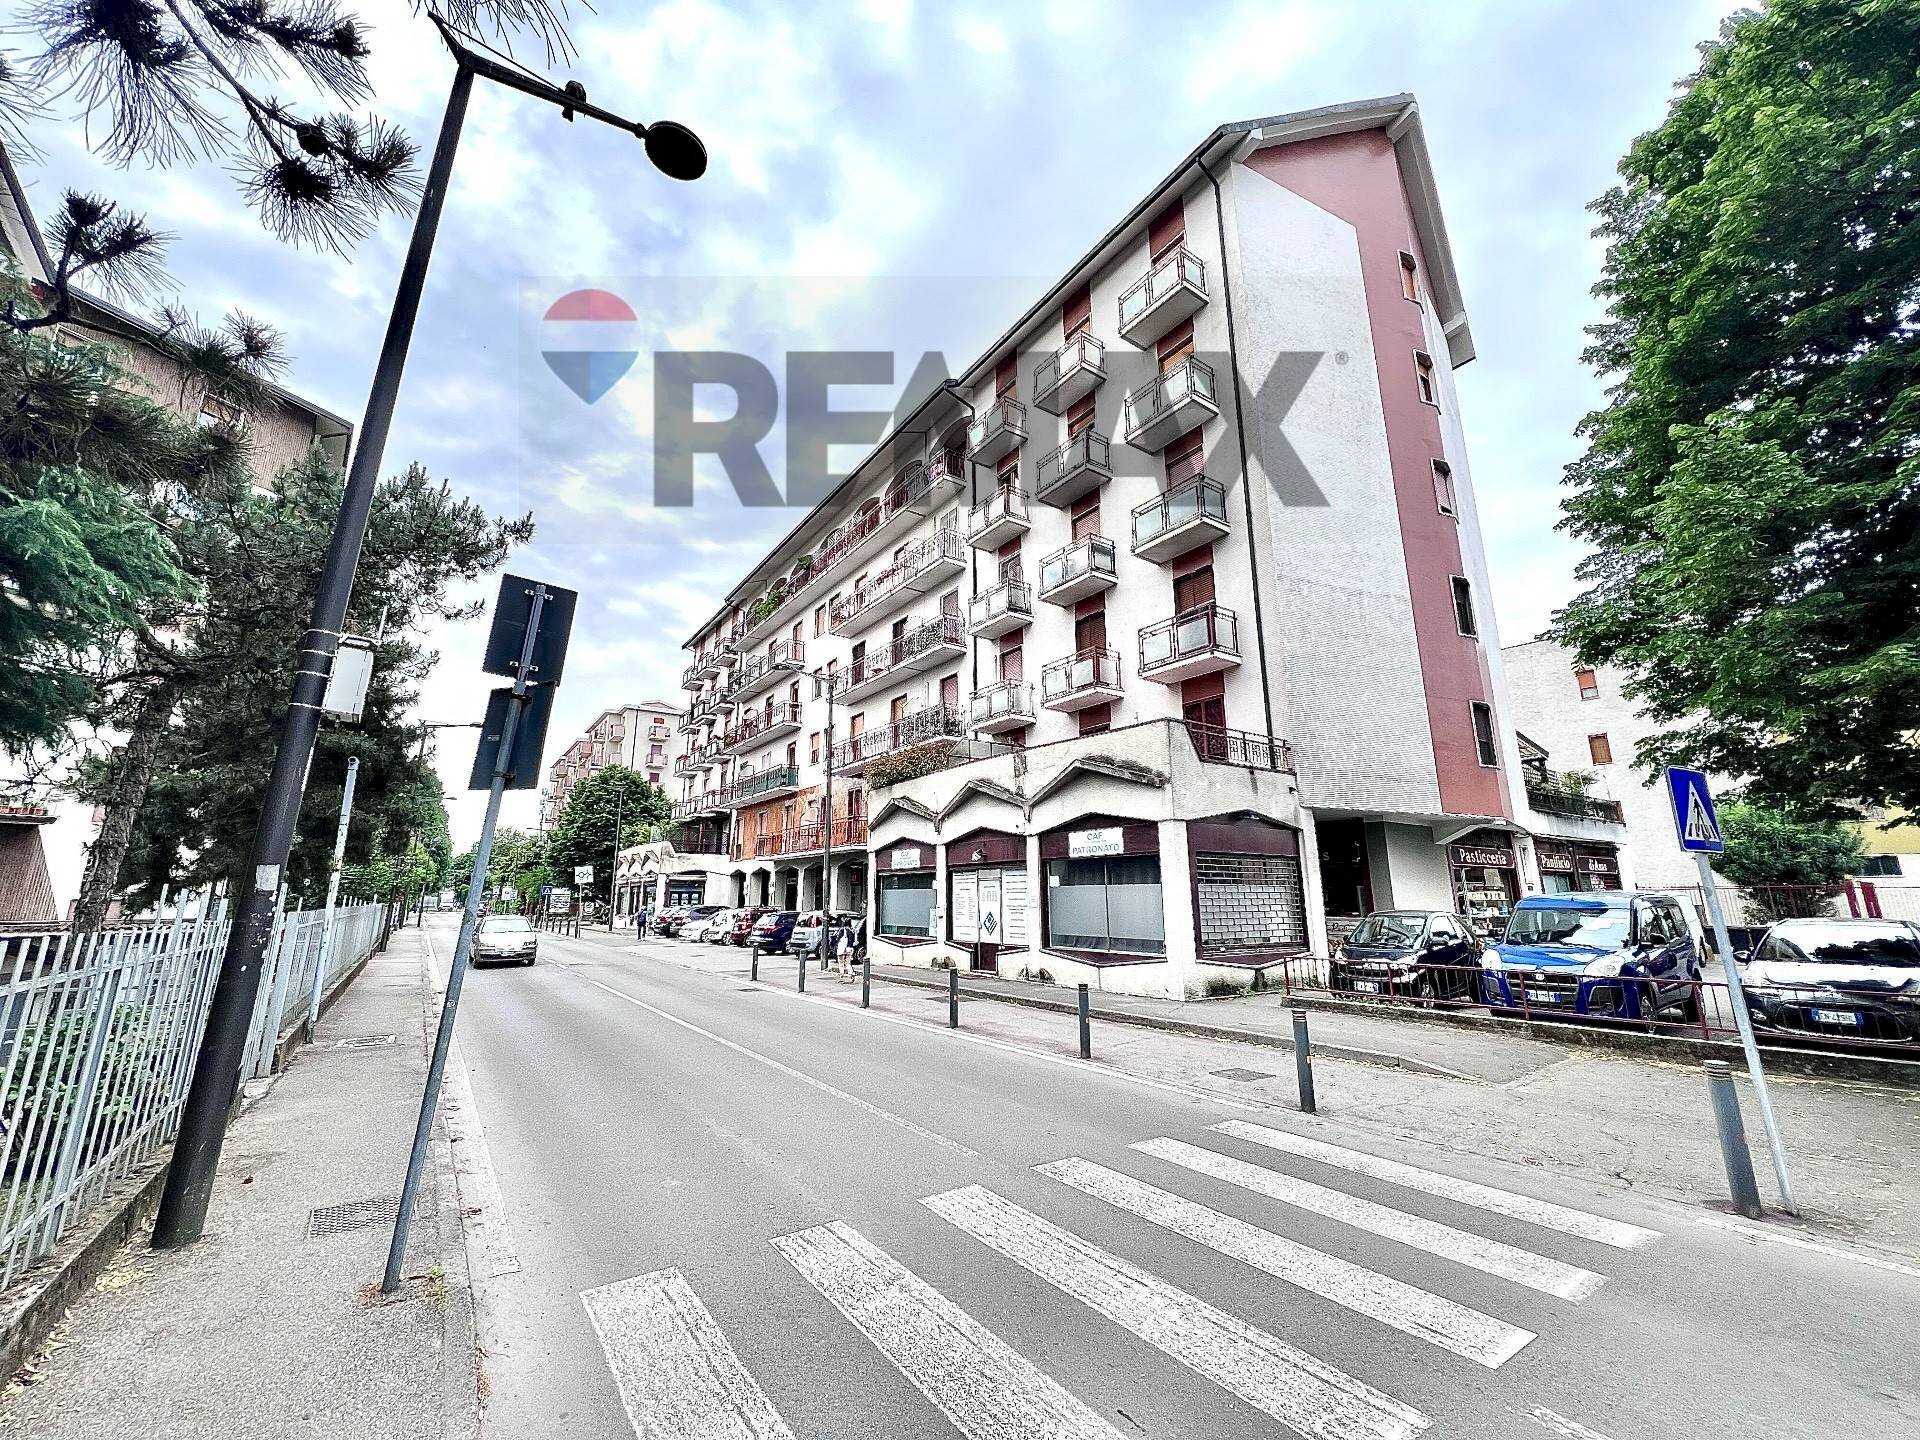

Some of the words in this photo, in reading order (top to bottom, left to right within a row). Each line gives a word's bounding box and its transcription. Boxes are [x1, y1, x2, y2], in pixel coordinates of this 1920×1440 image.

[1086, 831, 1103, 841] CAF
[1072, 843, 1120, 854] PATRONATO
[1458, 848, 1507, 865] Pasticceria
[1540, 854, 1571, 869] Panificio
